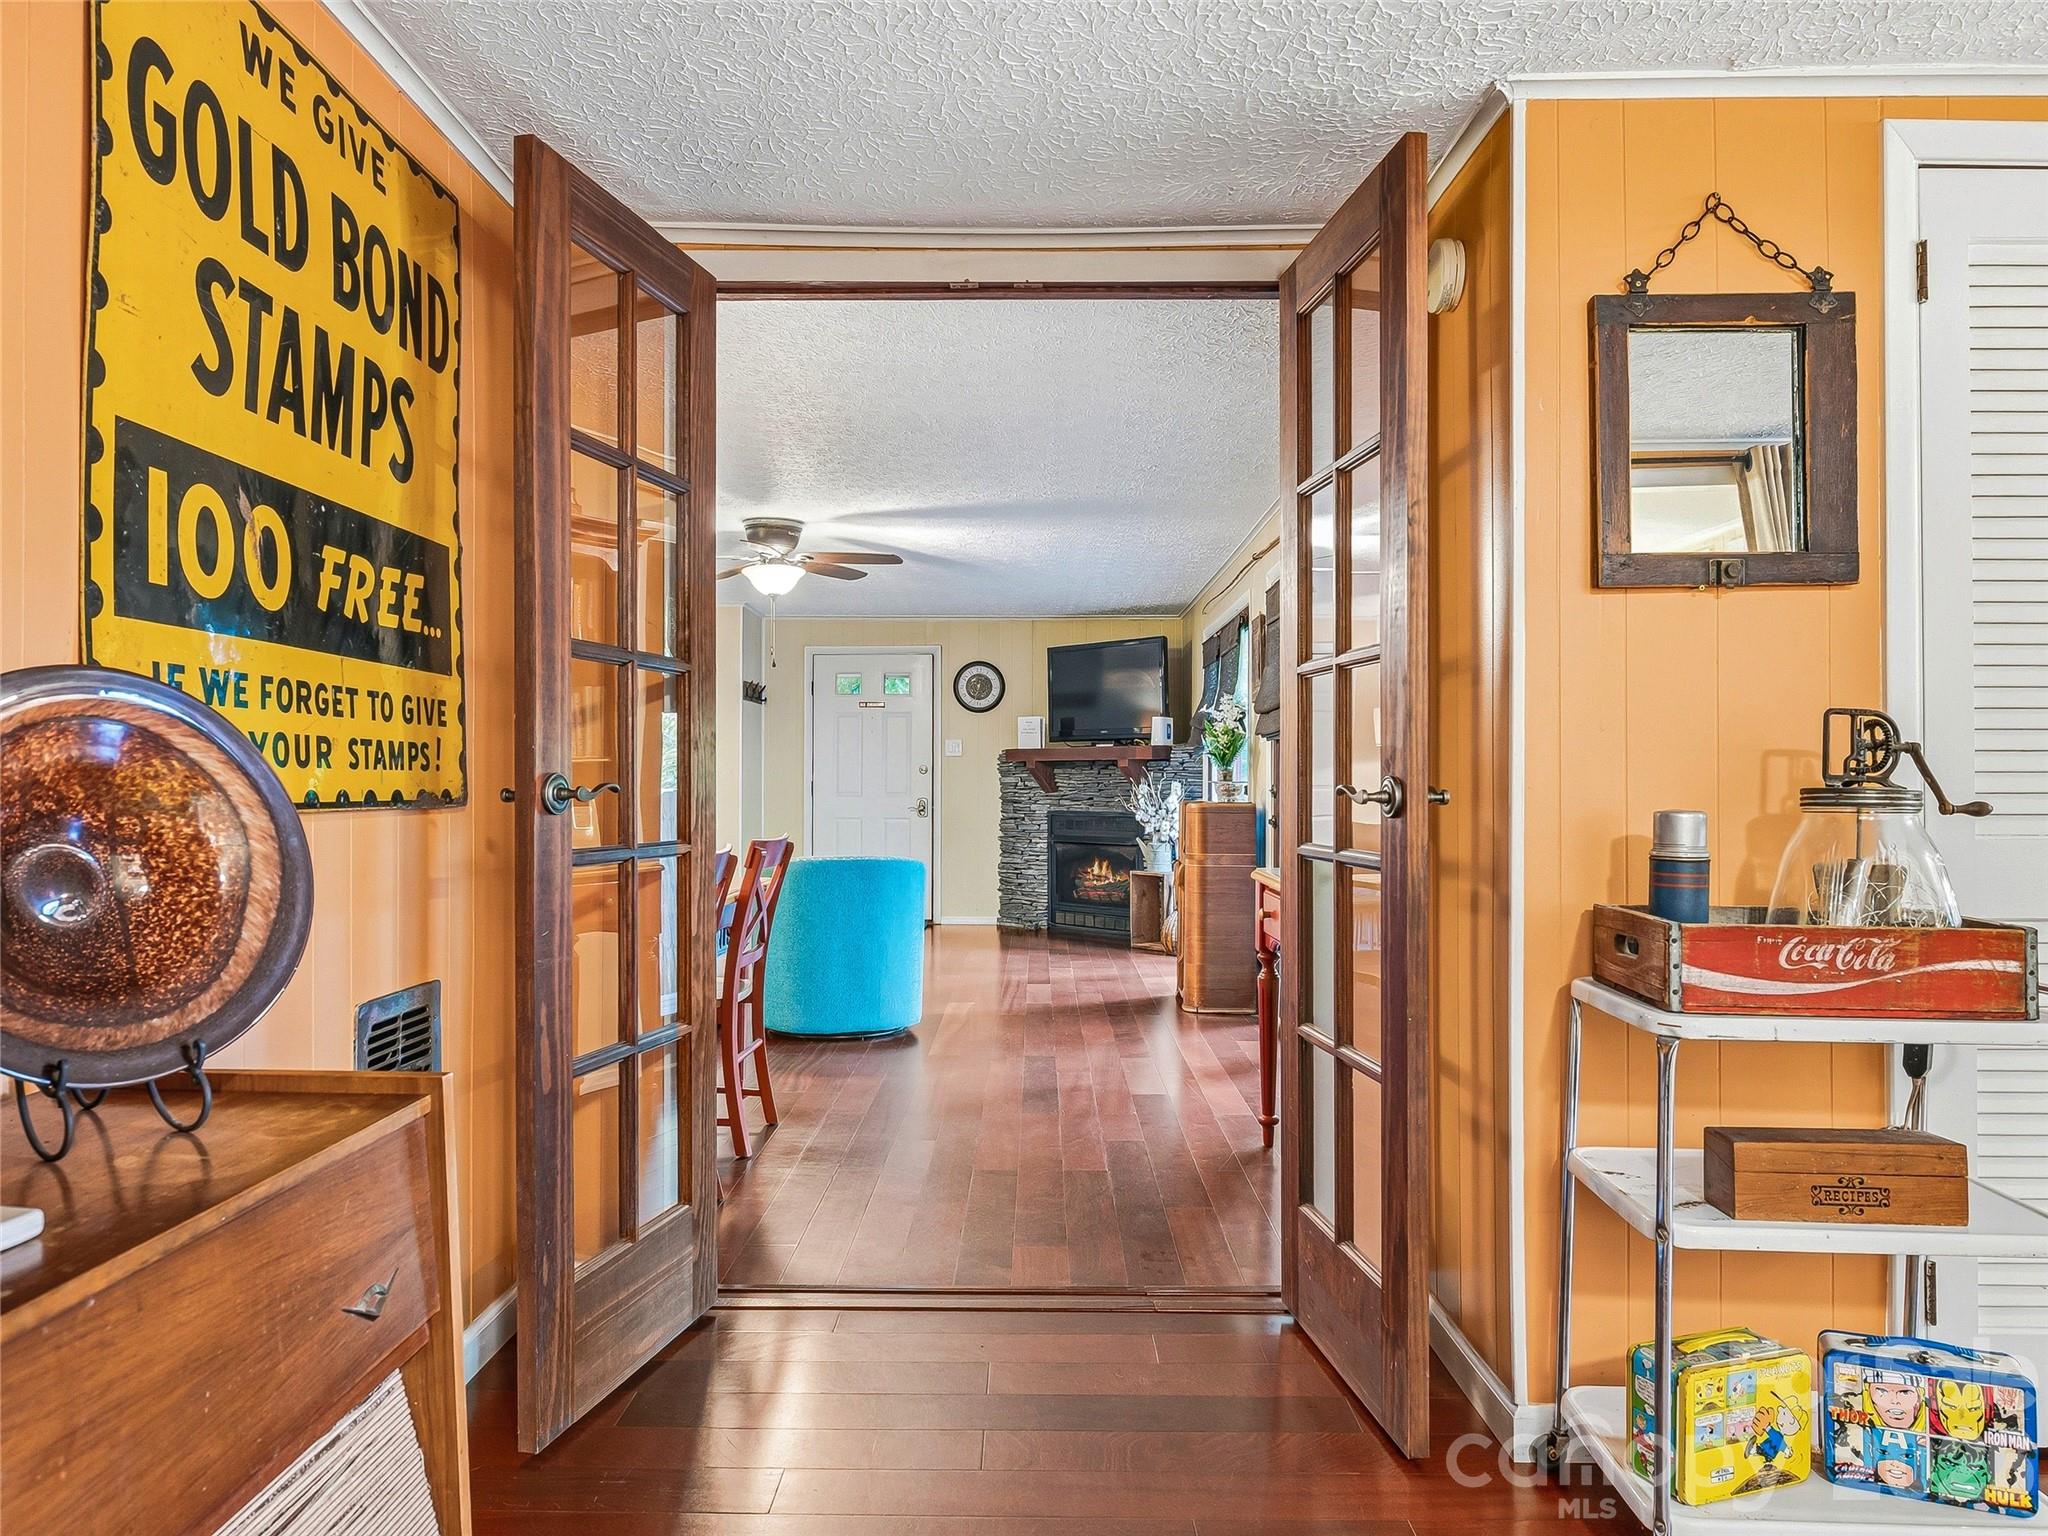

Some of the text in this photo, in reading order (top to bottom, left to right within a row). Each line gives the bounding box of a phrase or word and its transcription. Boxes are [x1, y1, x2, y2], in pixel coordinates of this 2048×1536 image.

[239, 20, 386, 196] WE GIVE
[127, 36, 450, 375] GOLD BOND
[191, 257, 415, 484] STAMPS
[148, 466, 292, 611] 100
[199, 667, 248, 708] WE
[261, 675, 358, 719] FORGET
[367, 690, 394, 723] TO
[402, 695, 447, 727] GIVE
[247, 731, 441, 772] YOUR STAMPS!
[1824, 1190, 1879, 1202] RECIPES
[1829, 1406, 1870, 1425] THOR
[1984, 1430, 2031, 1451] IRON MAN
[1985, 1486, 2033, 1509] HULK
